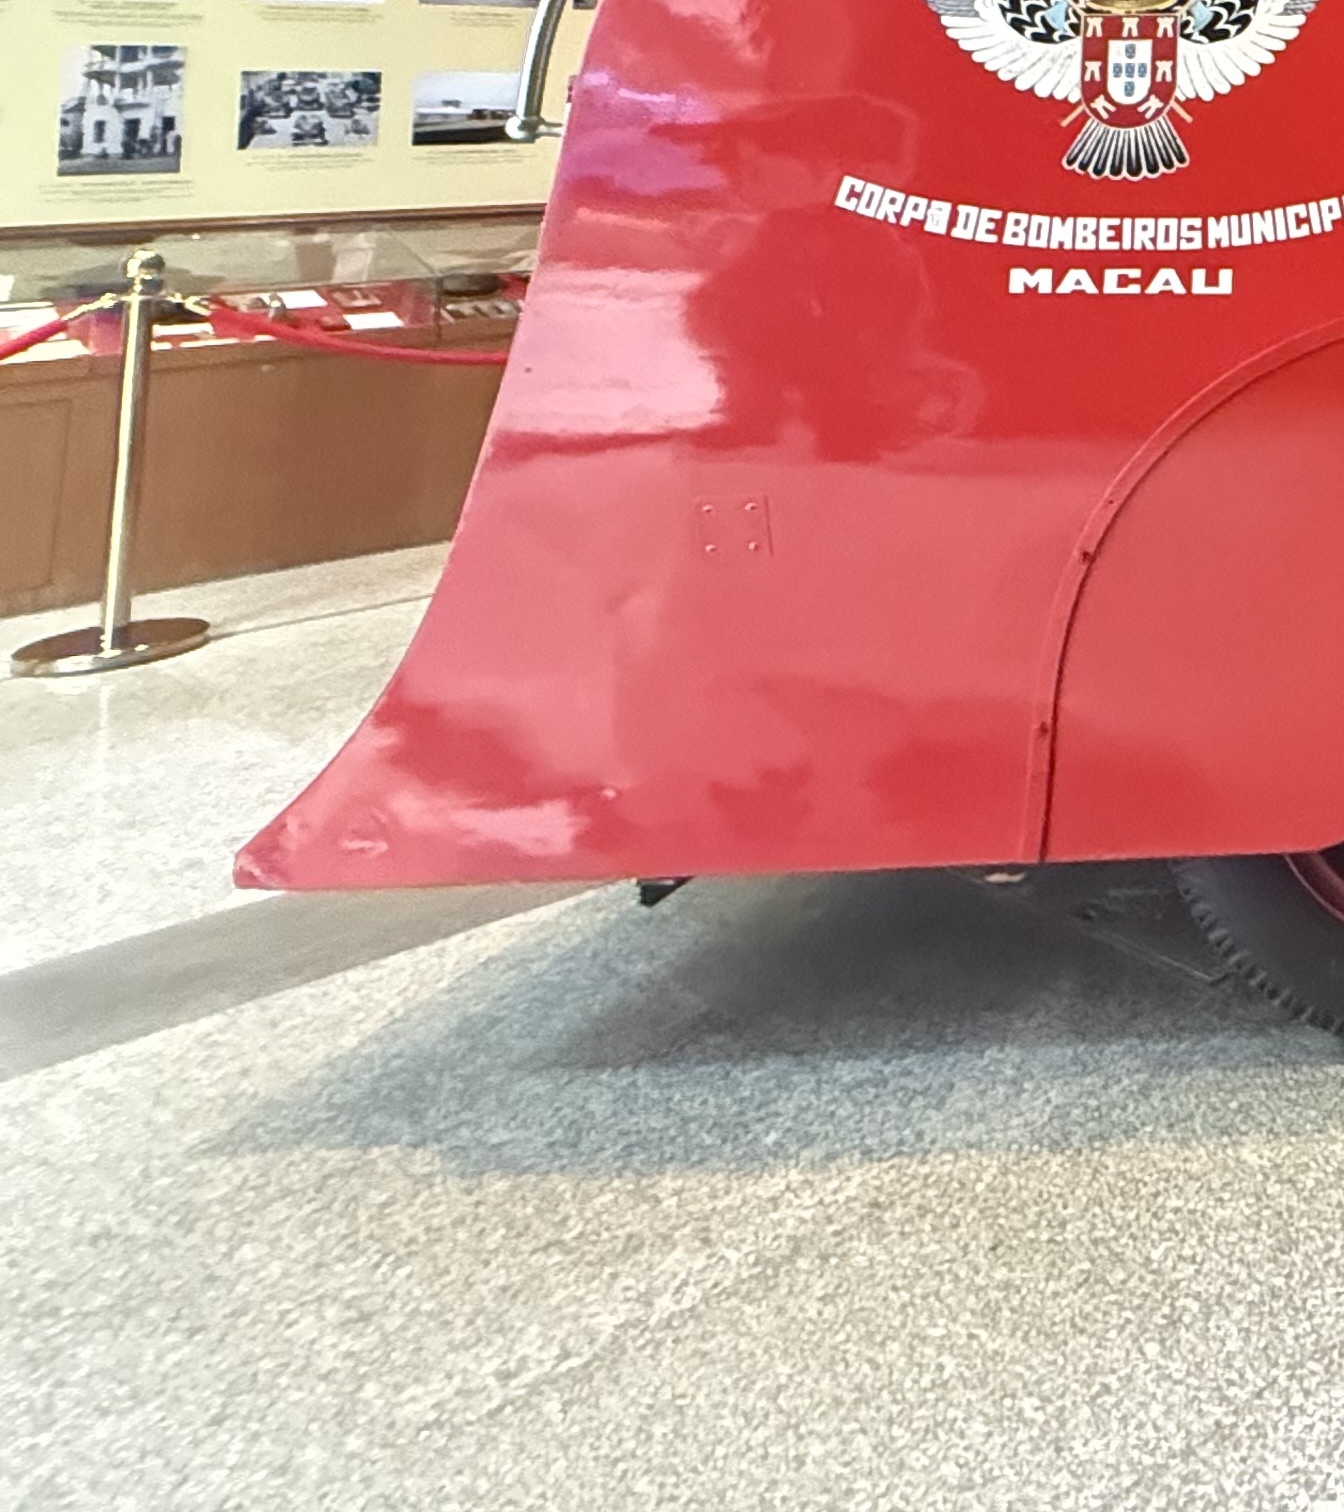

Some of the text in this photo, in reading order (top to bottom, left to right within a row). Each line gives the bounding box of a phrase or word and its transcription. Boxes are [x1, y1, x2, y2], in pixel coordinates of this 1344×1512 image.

[950, 204, 1003, 243] DE
[1002, 211, 1203, 251] BOMBEIROS
[1008, 268, 1233, 295] MACAU
